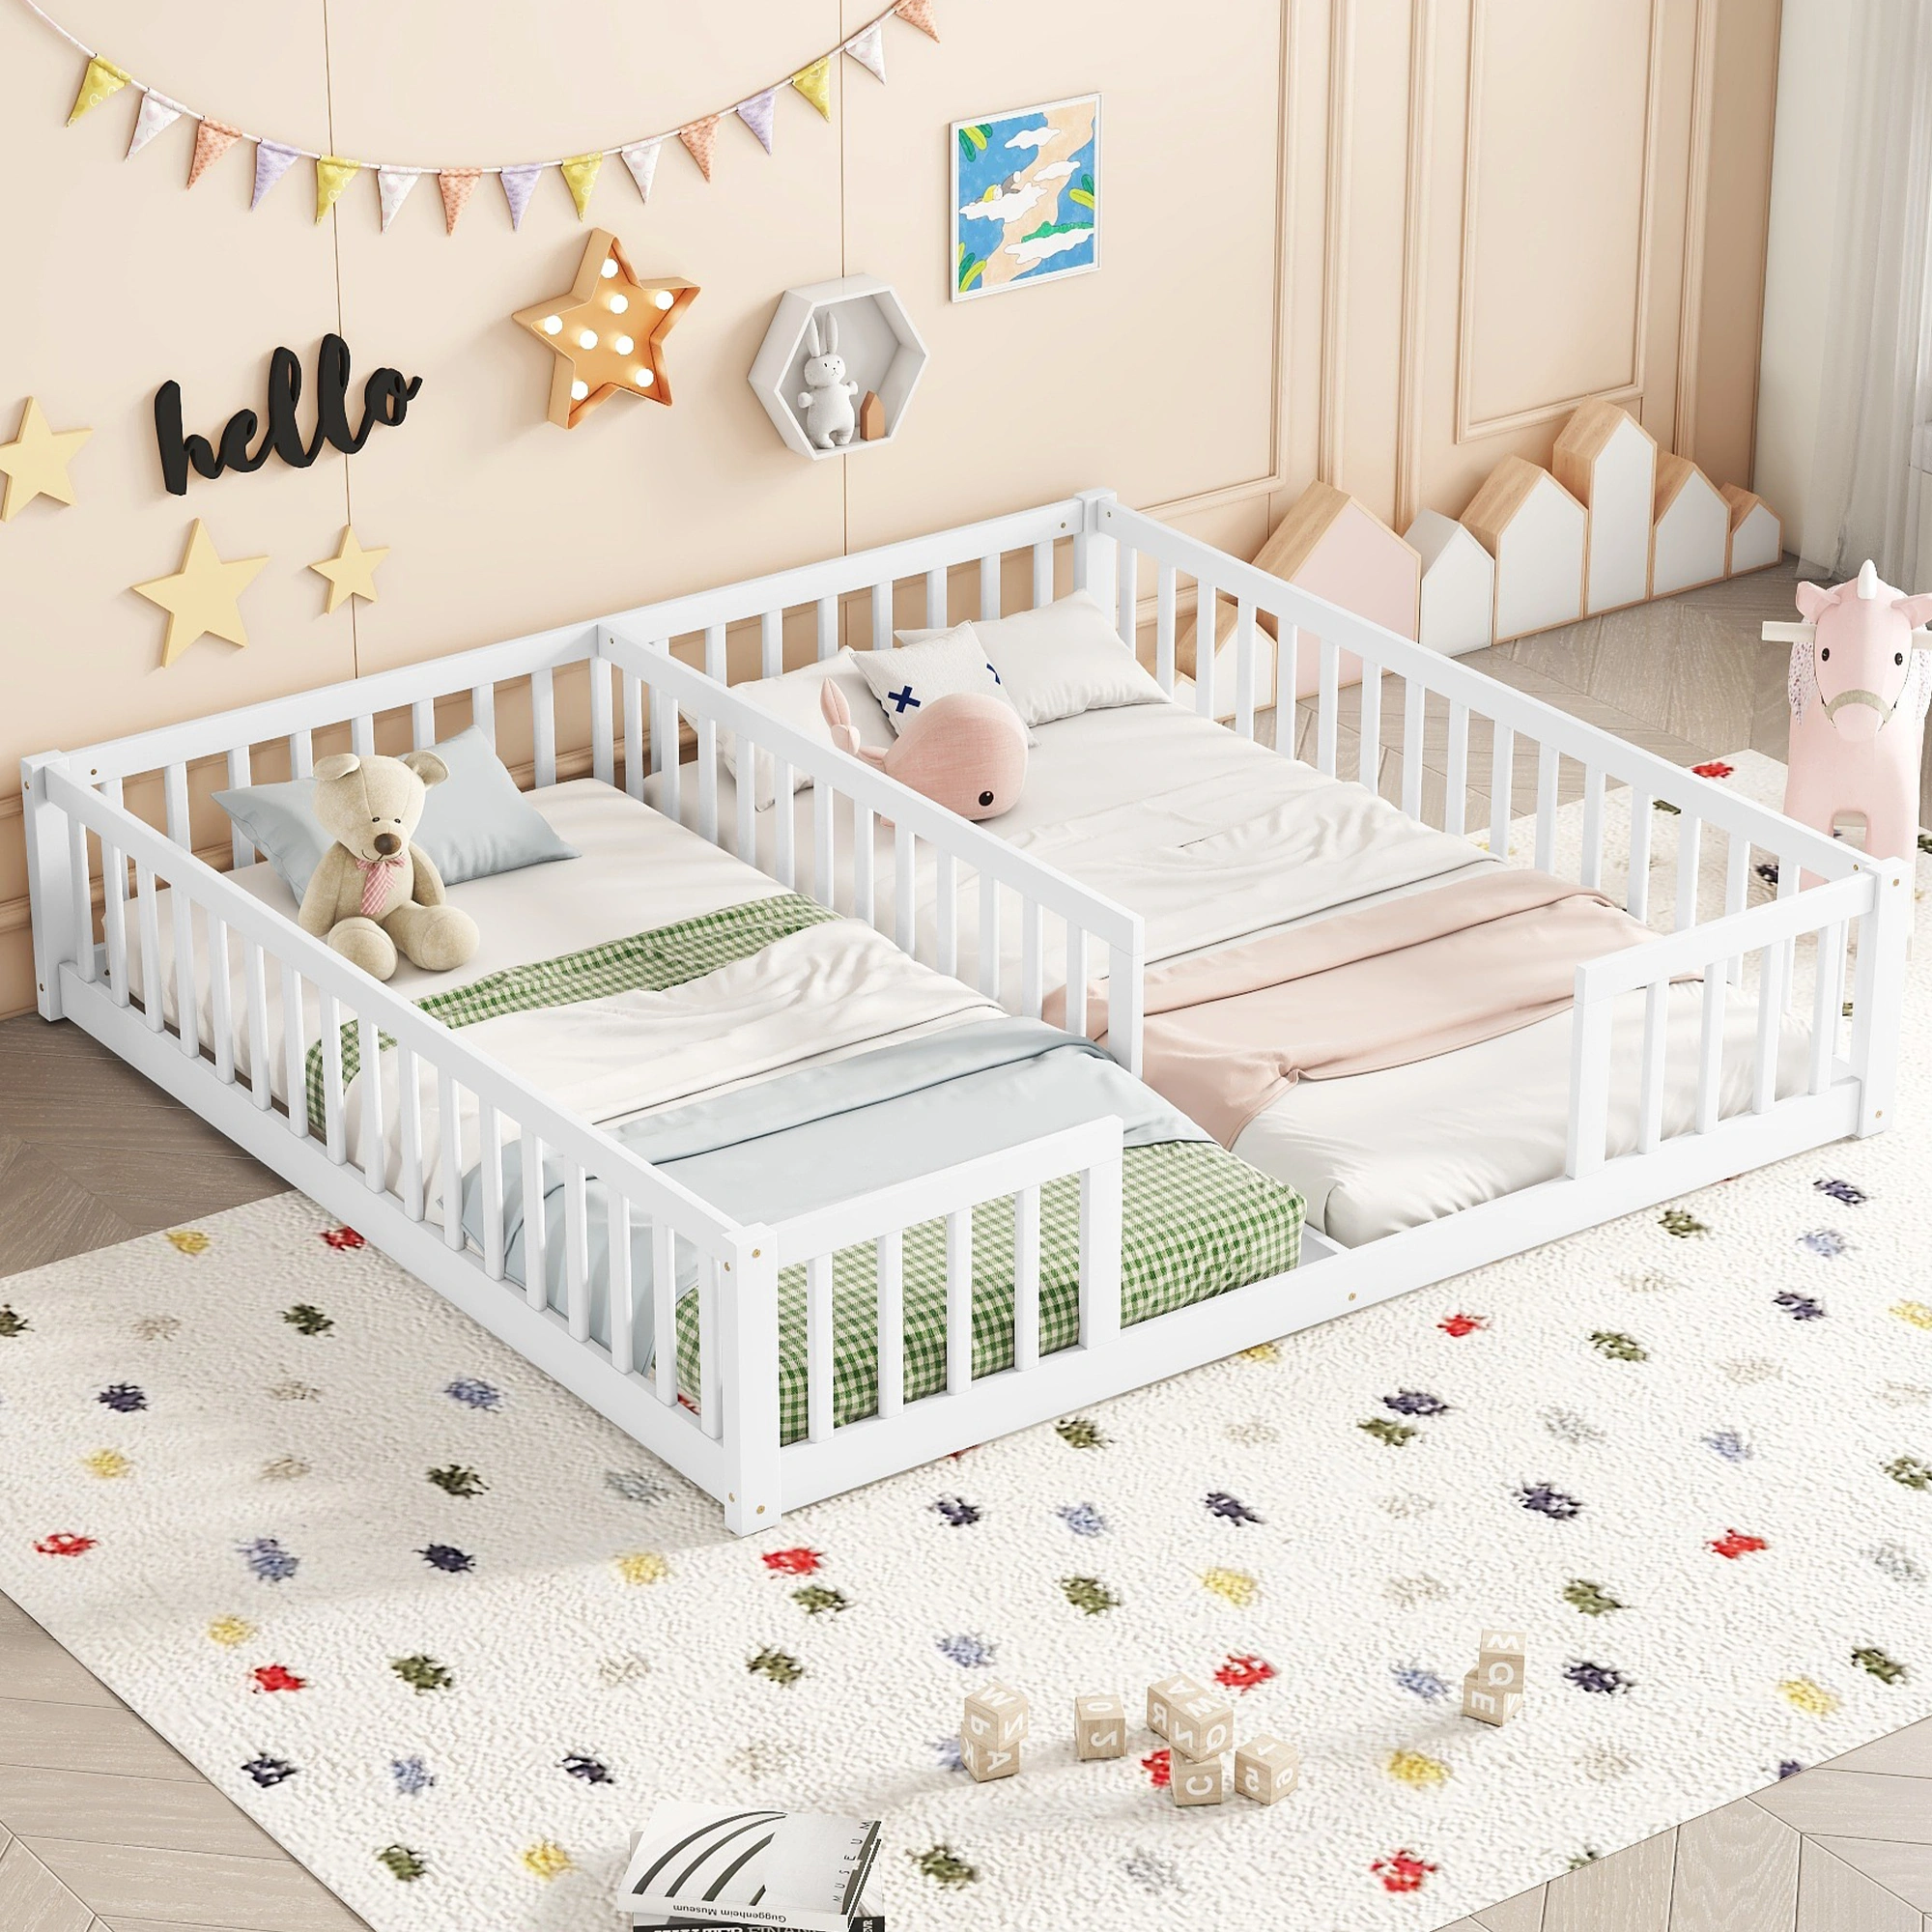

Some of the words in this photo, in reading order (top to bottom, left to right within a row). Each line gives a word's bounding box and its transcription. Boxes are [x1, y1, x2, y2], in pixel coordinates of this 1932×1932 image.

[154, 333, 423, 496] hello
[832, 1819, 874, 1903] MUSEUM
[672, 1904, 718, 1917] Museum
[720, 1908, 787, 1923] Guggenheim
